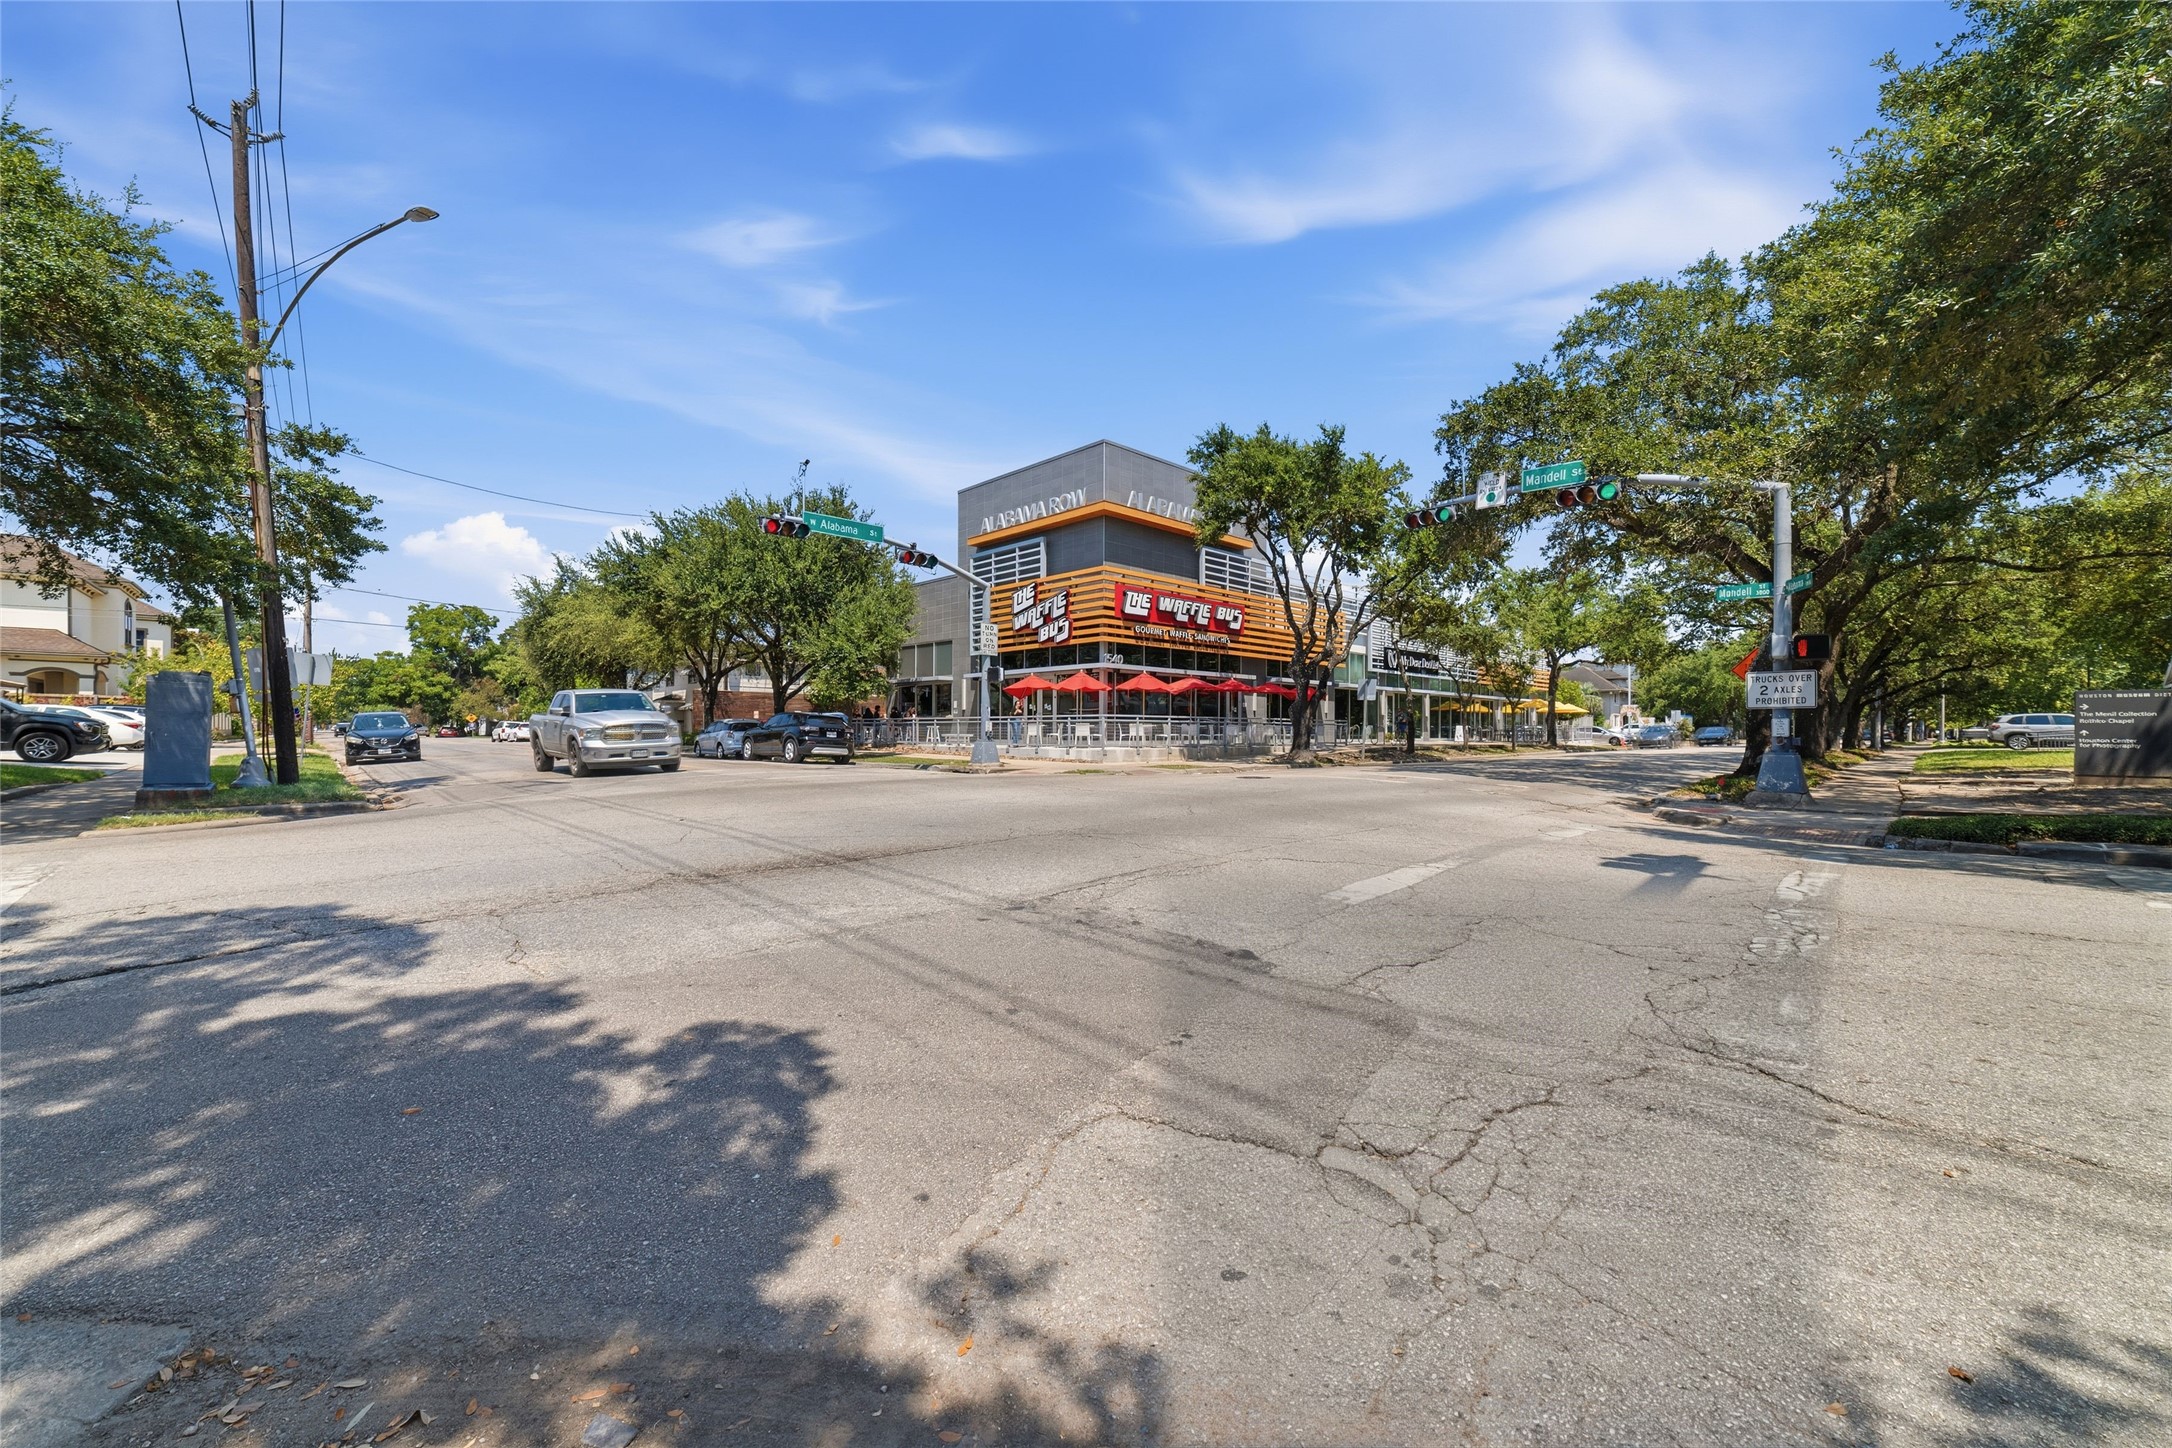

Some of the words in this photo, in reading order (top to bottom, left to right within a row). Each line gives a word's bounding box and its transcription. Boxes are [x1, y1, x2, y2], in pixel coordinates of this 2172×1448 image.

[1526, 469, 1566, 487] Mandell
[1571, 467, 1583, 477] St
[980, 500, 1048, 535] ALABAMA
[1048, 487, 1087, 516] ROW
[810, 518, 816, 526] W
[820, 519, 858, 535] Alabama
[869, 529, 877, 537] St
[1012, 582, 1036, 614] THE
[1719, 587, 1752, 598] Mandell
[1013, 590, 1068, 631] WAFFLE
[1123, 590, 1153, 616] THE
[1157, 596, 1212, 625] WAFFLE
[1215, 606, 1243, 630] BUS
[1038, 617, 1070, 643] BUS
[1135, 625, 1168, 637] GOURMET
[1169, 630, 1193, 640] WAFFLE
[1194, 633, 1231, 644] SANDWICHES
[1103, 653, 1124, 665] 1540
[1751, 675, 1784, 684] TRUCKS
[1788, 674, 1812, 682] OVER
[1760, 685, 1768, 695] 2
[1755, 697, 1807, 705] PROHIBITED
